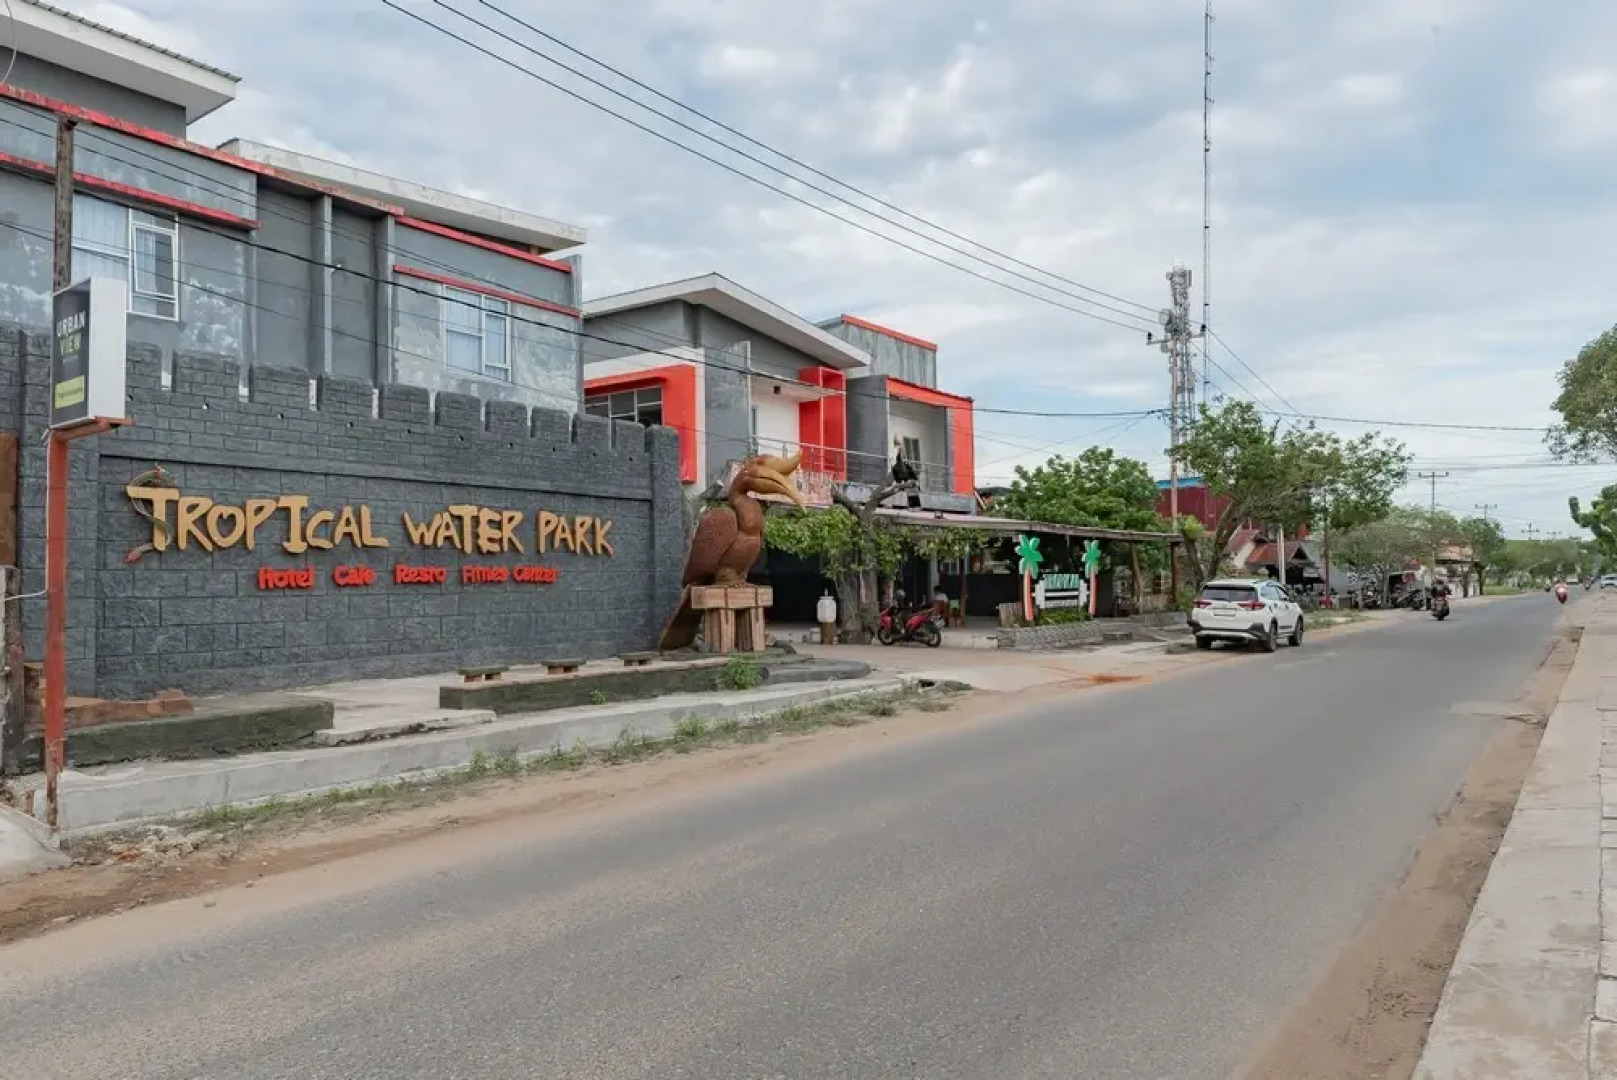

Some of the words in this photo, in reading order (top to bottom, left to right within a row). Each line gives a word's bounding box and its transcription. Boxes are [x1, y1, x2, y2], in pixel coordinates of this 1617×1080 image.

[56, 311, 86, 337] URBAN
[59, 333, 82, 356] VIEW
[126, 485, 389, 554] TROPICAL
[403, 504, 524, 554] WATER
[537, 510, 615, 555] PARK
[258, 566, 315, 590] Hotel
